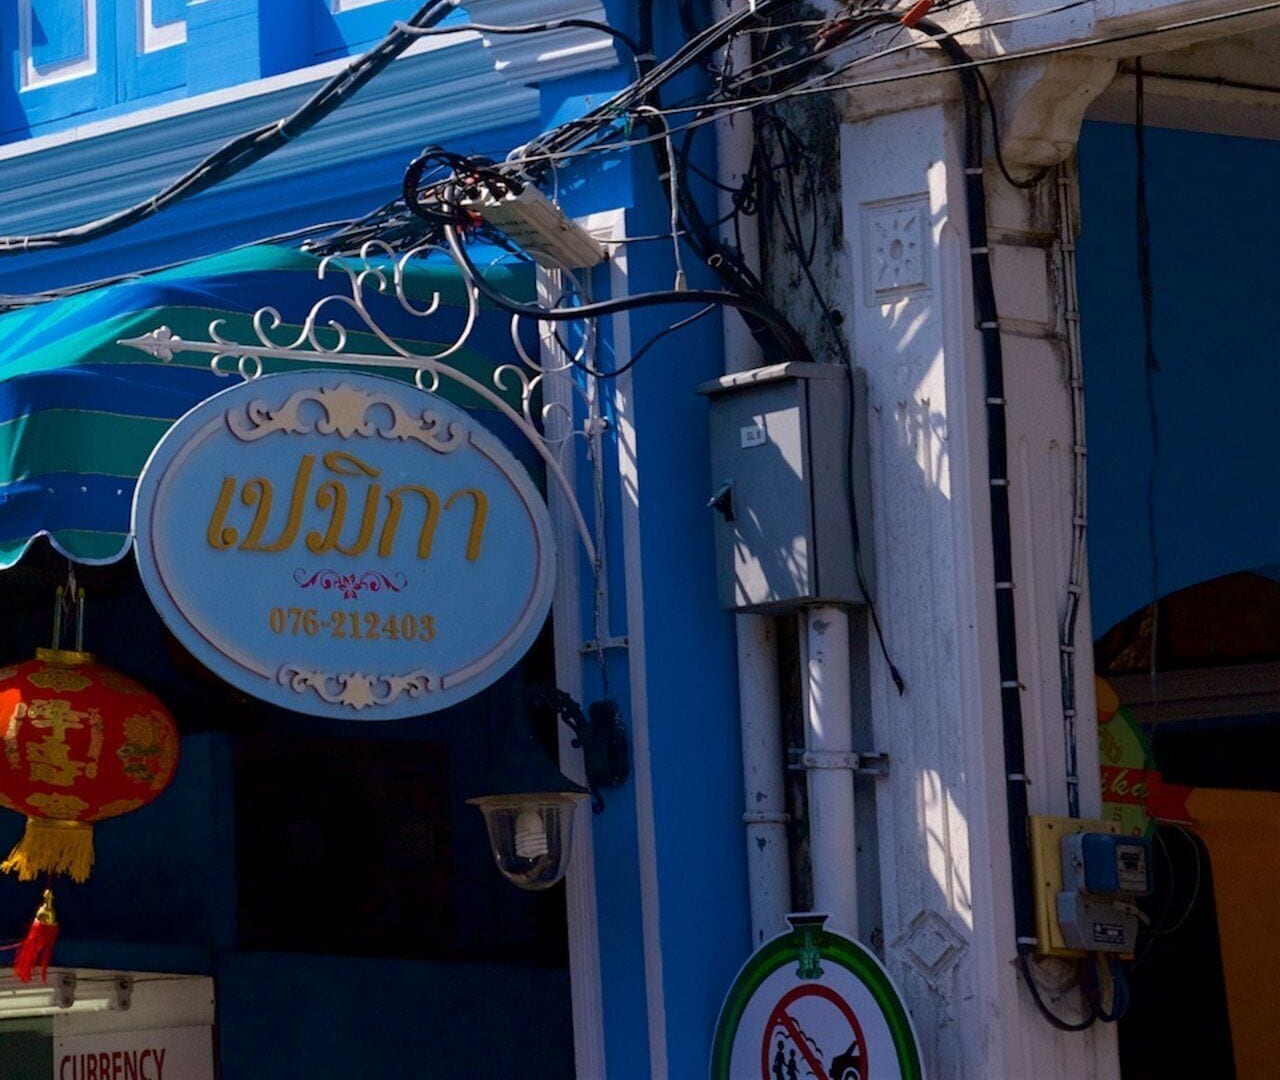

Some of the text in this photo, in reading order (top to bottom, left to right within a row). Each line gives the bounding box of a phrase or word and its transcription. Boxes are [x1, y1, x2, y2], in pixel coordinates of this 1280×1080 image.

[206, 451, 489, 563] เปมิกา
[268, 607, 438, 642] 076-212403
[60, 1048, 166, 1080] CURRENCY
